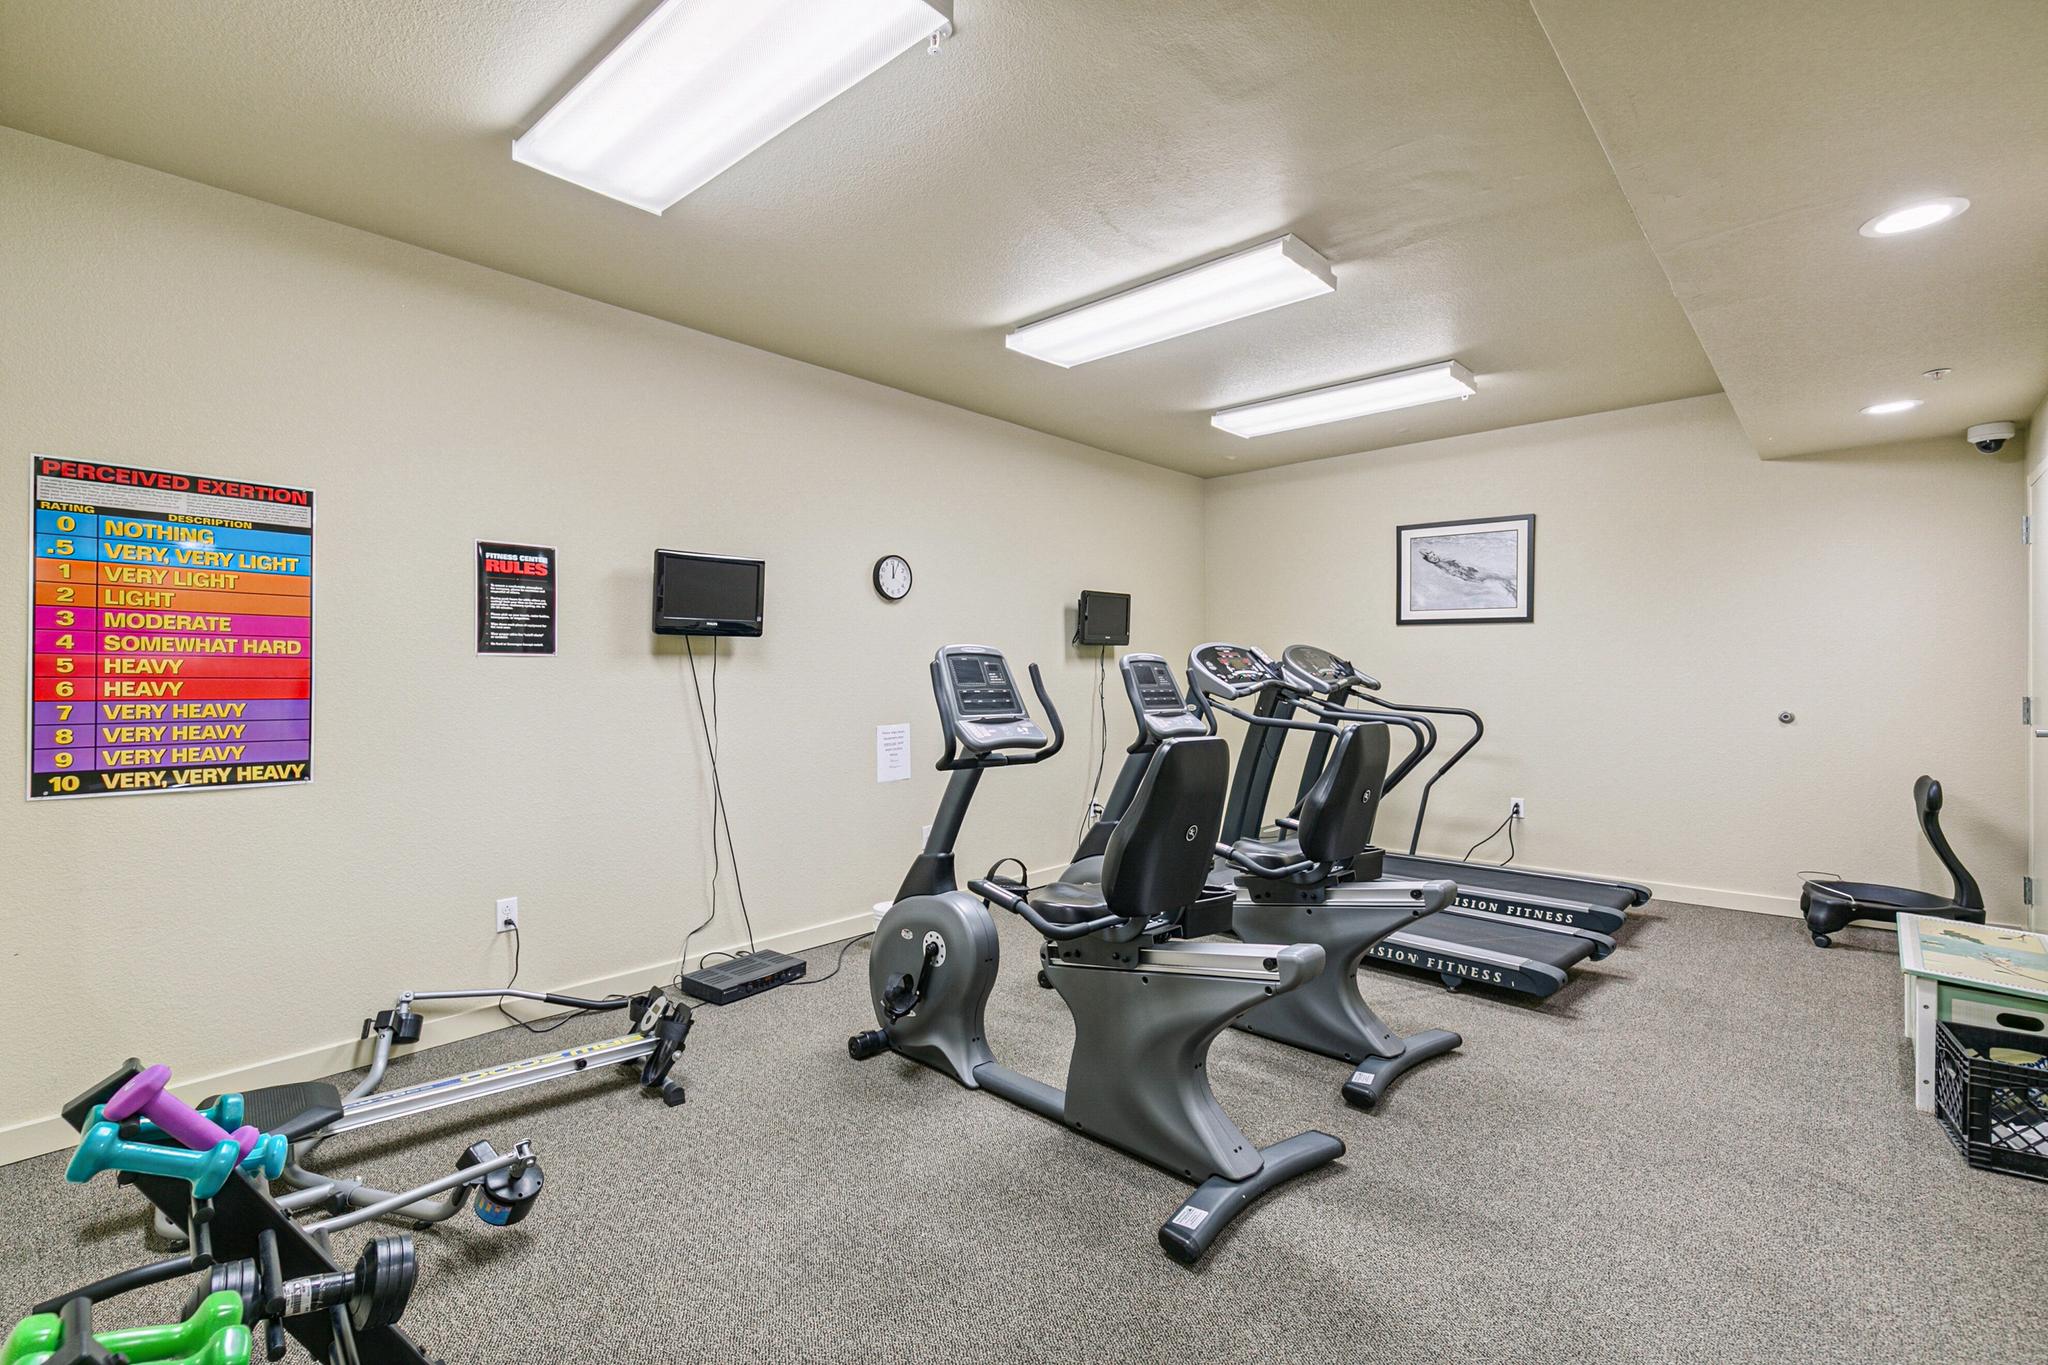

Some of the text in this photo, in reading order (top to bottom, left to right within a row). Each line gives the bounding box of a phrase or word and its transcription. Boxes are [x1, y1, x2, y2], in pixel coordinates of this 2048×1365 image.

[42, 459, 190, 491] PERCEIVED
[198, 477, 308, 505] EXERTION
[40, 501, 95, 515] RATING
[56, 516, 76, 532] 0
[168, 514, 252, 529] DESCRIPTION
[105, 520, 214, 544] NOTHING
[47, 540, 74, 555] .5
[485, 552, 518, 560] FITNESS
[104, 543, 299, 572] VERY, VERY LIGHT
[57, 563, 71, 579] 1
[485, 559, 548, 576] RULES
[104, 566, 239, 589] VERY LIGHT
[56, 587, 75, 603] 2
[104, 590, 176, 608] LIGHT
[56, 610, 74, 627] 3
[104, 613, 232, 632] MODERATE
[55, 634, 74, 650] 4
[103, 635, 301, 655] SOMEWHAT HARD
[56, 658, 74, 673] 5
[103, 658, 184, 674] HEAVY
[55, 681, 74, 697] 6
[103, 681, 184, 697] HEAVY
[56, 705, 74, 721] 7
[103, 703, 246, 721] VERY HEAVY
[55, 729, 74, 744] 8
[102, 724, 246, 744] VERY HEAVY
[55, 752, 74, 768] 9
[102, 745, 245, 767] VERY HEAVY
[48, 775, 80, 792] 10
[101, 763, 306, 791] VERY, VERY HEAVY
[1454, 897, 1574, 924] ISION FITNESS
[1369, 946, 1503, 983] ISION FITNESS
